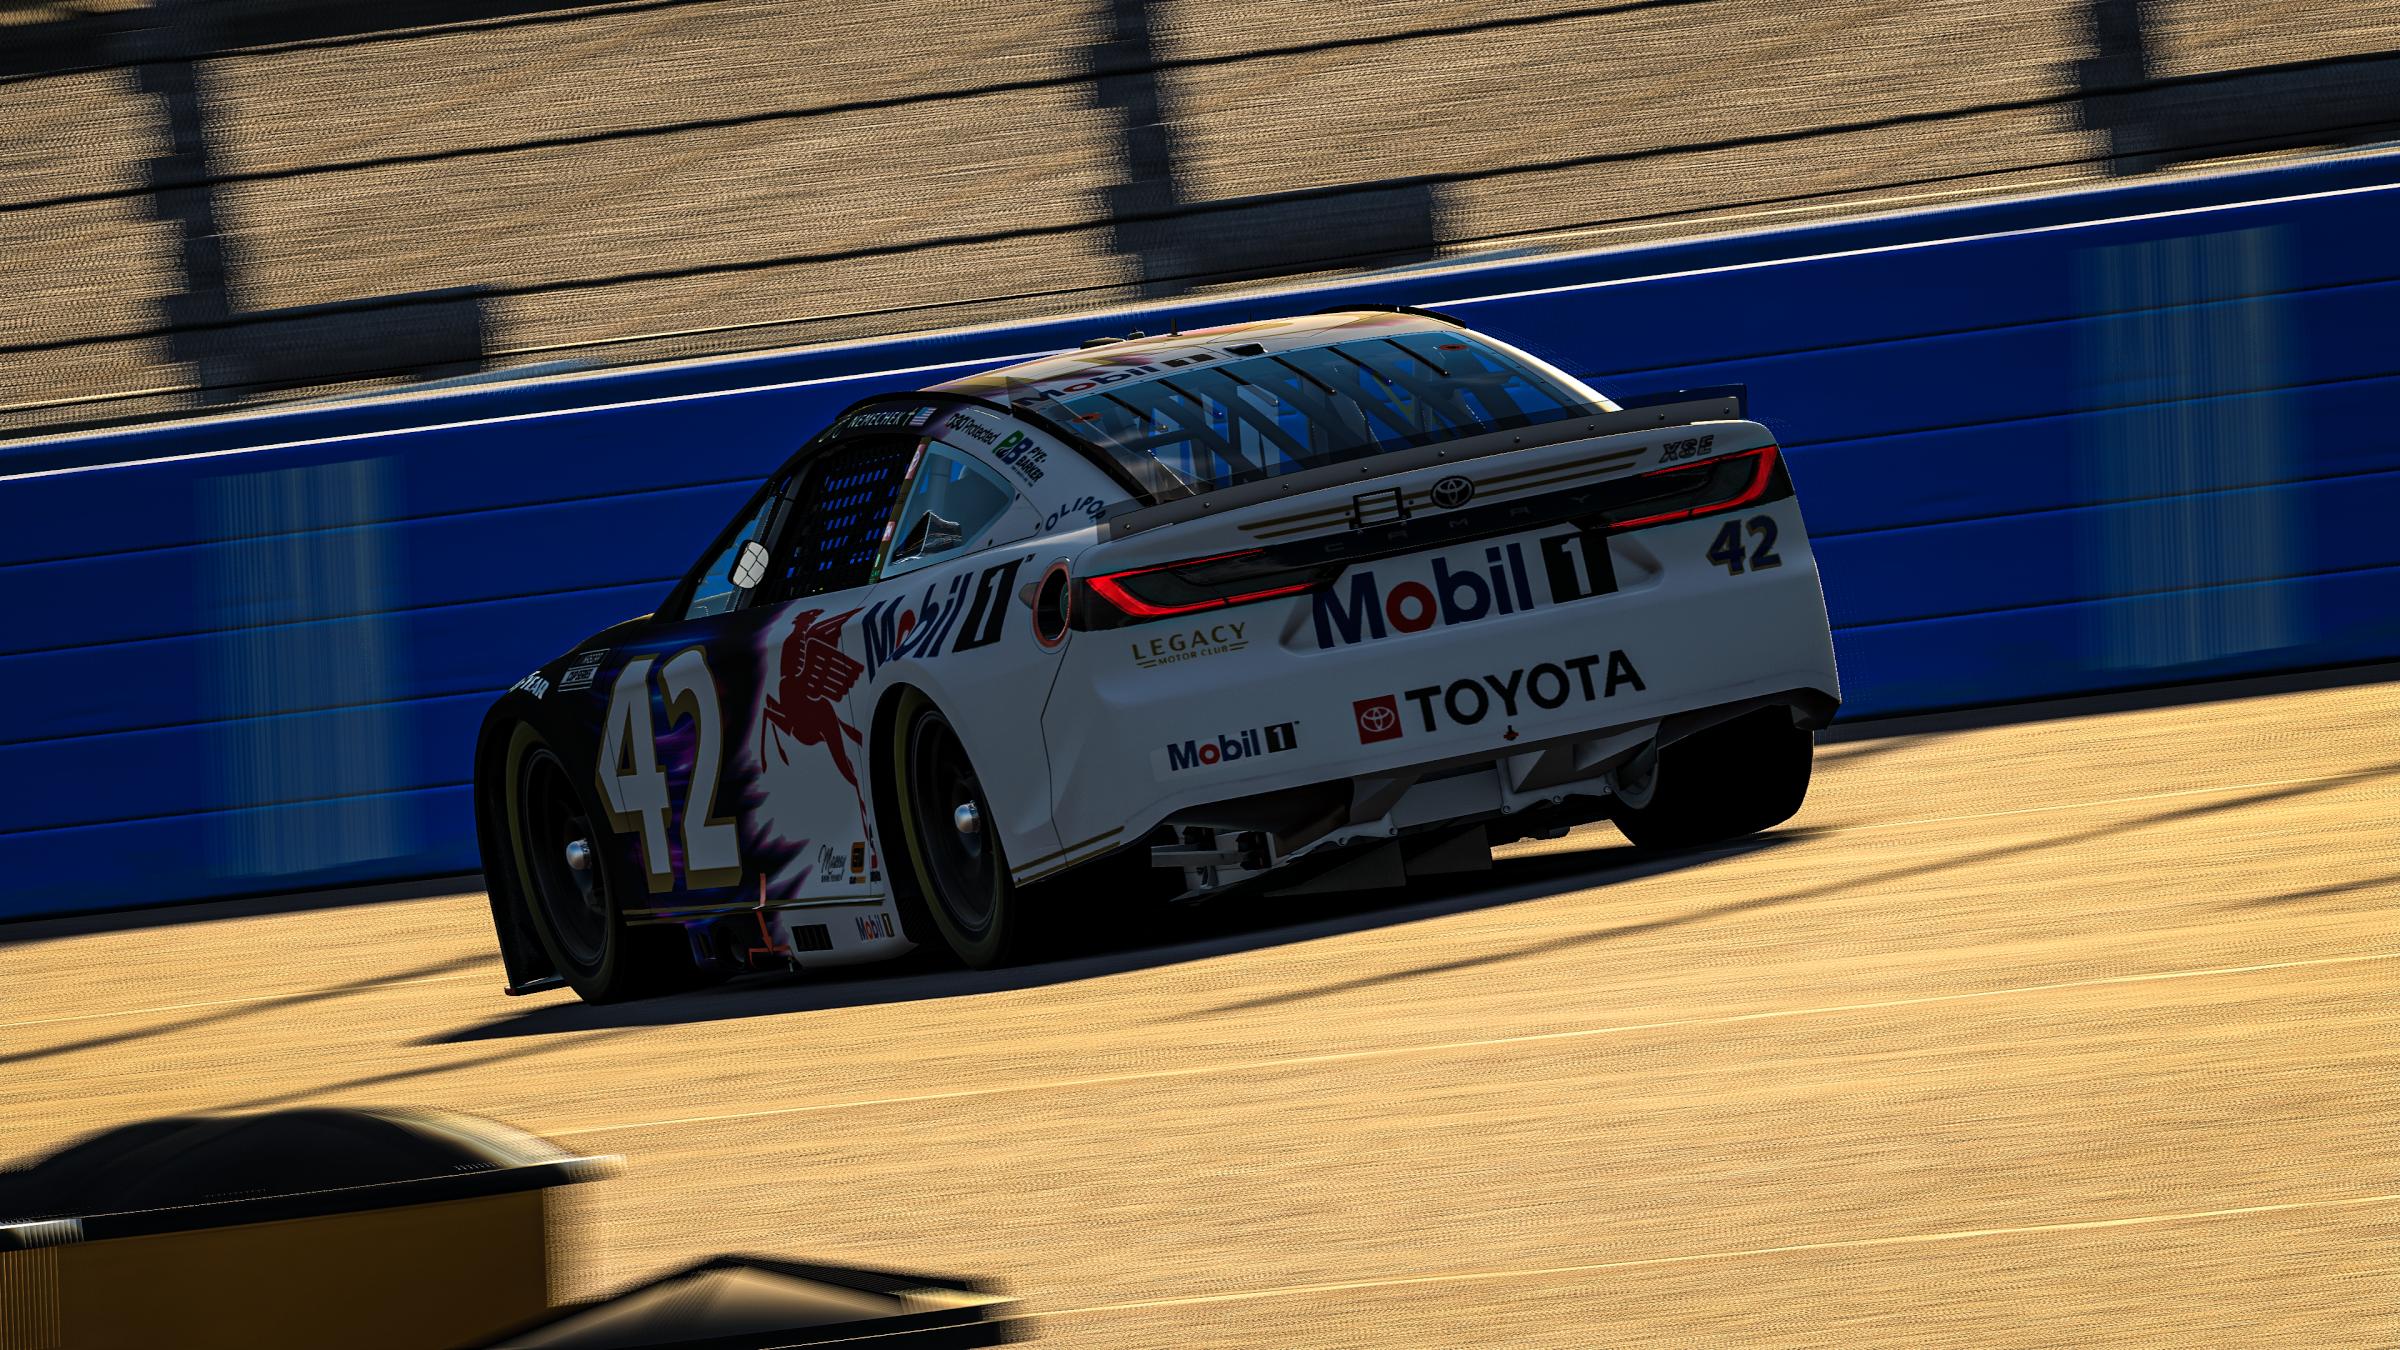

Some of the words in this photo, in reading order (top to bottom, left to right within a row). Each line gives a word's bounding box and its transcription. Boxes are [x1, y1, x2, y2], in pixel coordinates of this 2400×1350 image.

[1015, 455, 1044, 483] BARKER
[1659, 435, 1714, 463] XSE
[1706, 515, 1782, 576] 42
[1313, 542, 1535, 649] Mobil
[862, 571, 974, 684] Mobil
[1132, 622, 1246, 660] LEGACY
[1158, 652, 1198, 665] MOTOR
[1201, 645, 1229, 657] CLUB
[1405, 650, 1646, 733] TOYOTA
[595, 645, 742, 893] 42
[1167, 729, 1261, 771] Mobil
[855, 914, 885, 941] Mobil
